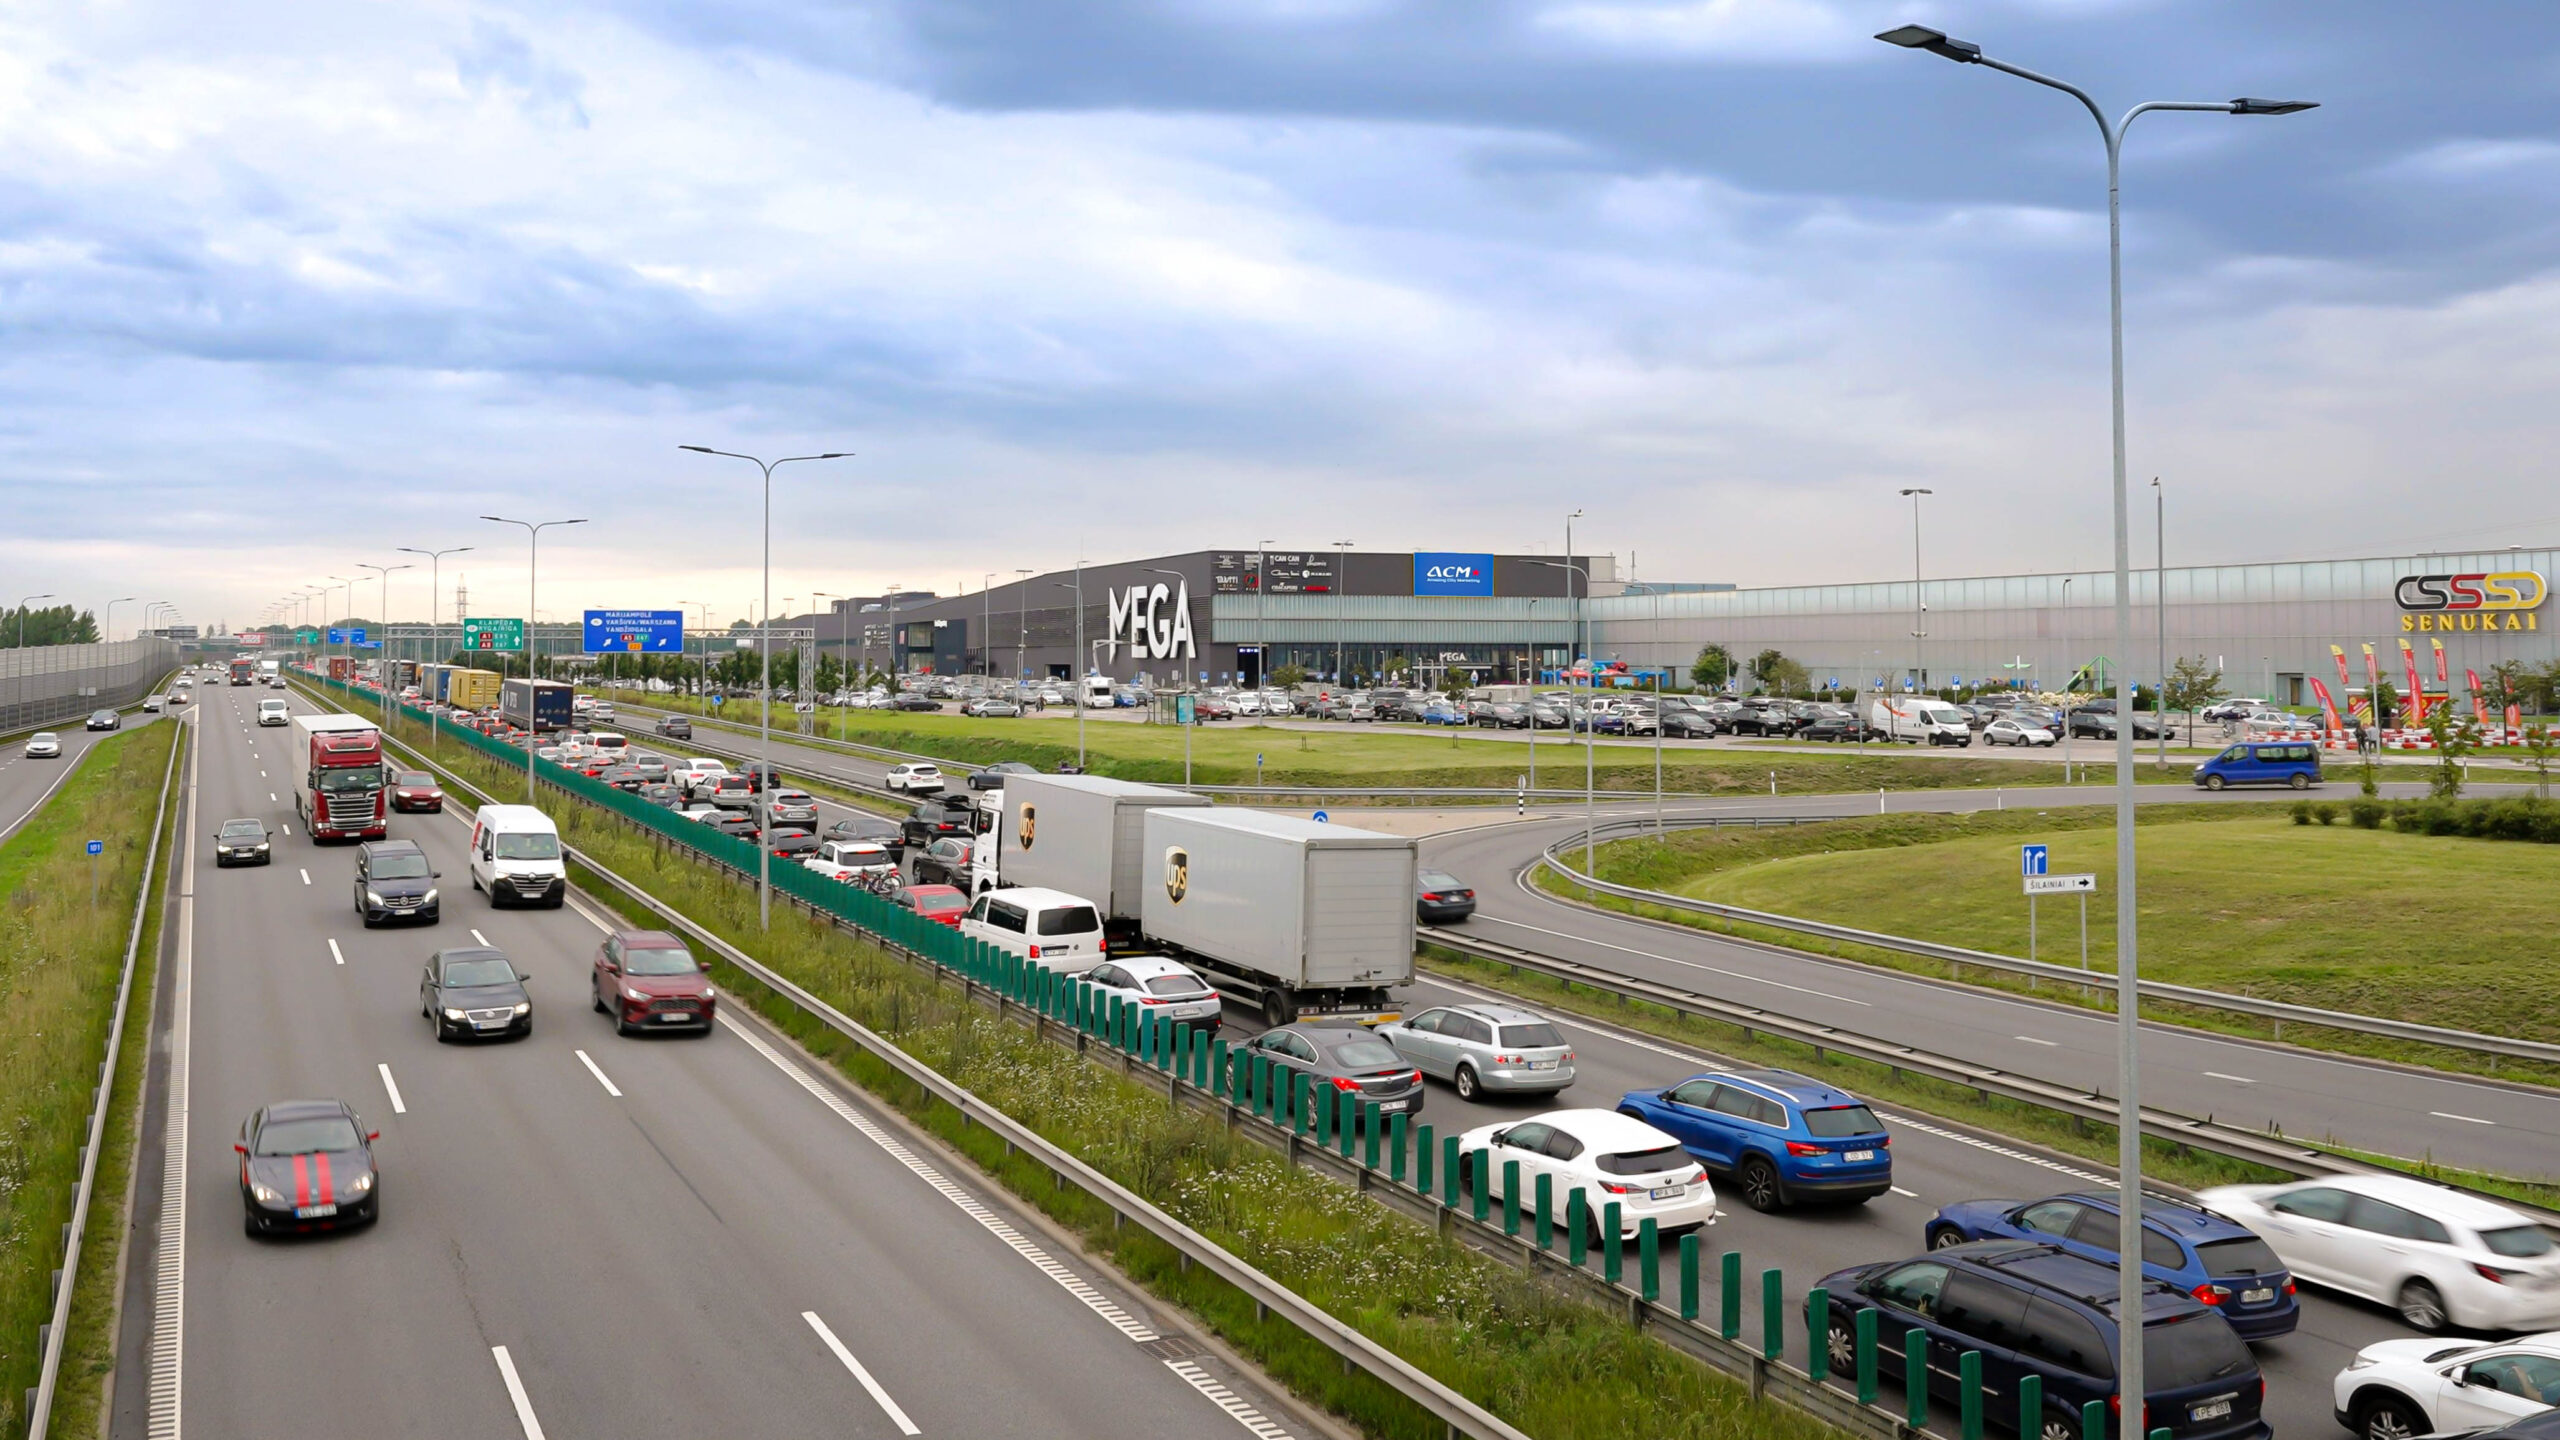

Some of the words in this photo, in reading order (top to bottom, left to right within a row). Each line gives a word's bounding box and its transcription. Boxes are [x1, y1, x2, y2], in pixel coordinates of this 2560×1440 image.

[1427, 566, 1471, 578] ACM
[1109, 580, 1196, 664] MEGA
[2401, 612, 2537, 632] SENUKAI
[1439, 652, 1467, 662] MEGA
[1020, 817, 1034, 845] ups
[1167, 863, 1187, 897] ups
[2030, 879, 2066, 890] ŠILAINIAI
[2195, 1406, 2212, 1420] KPE
